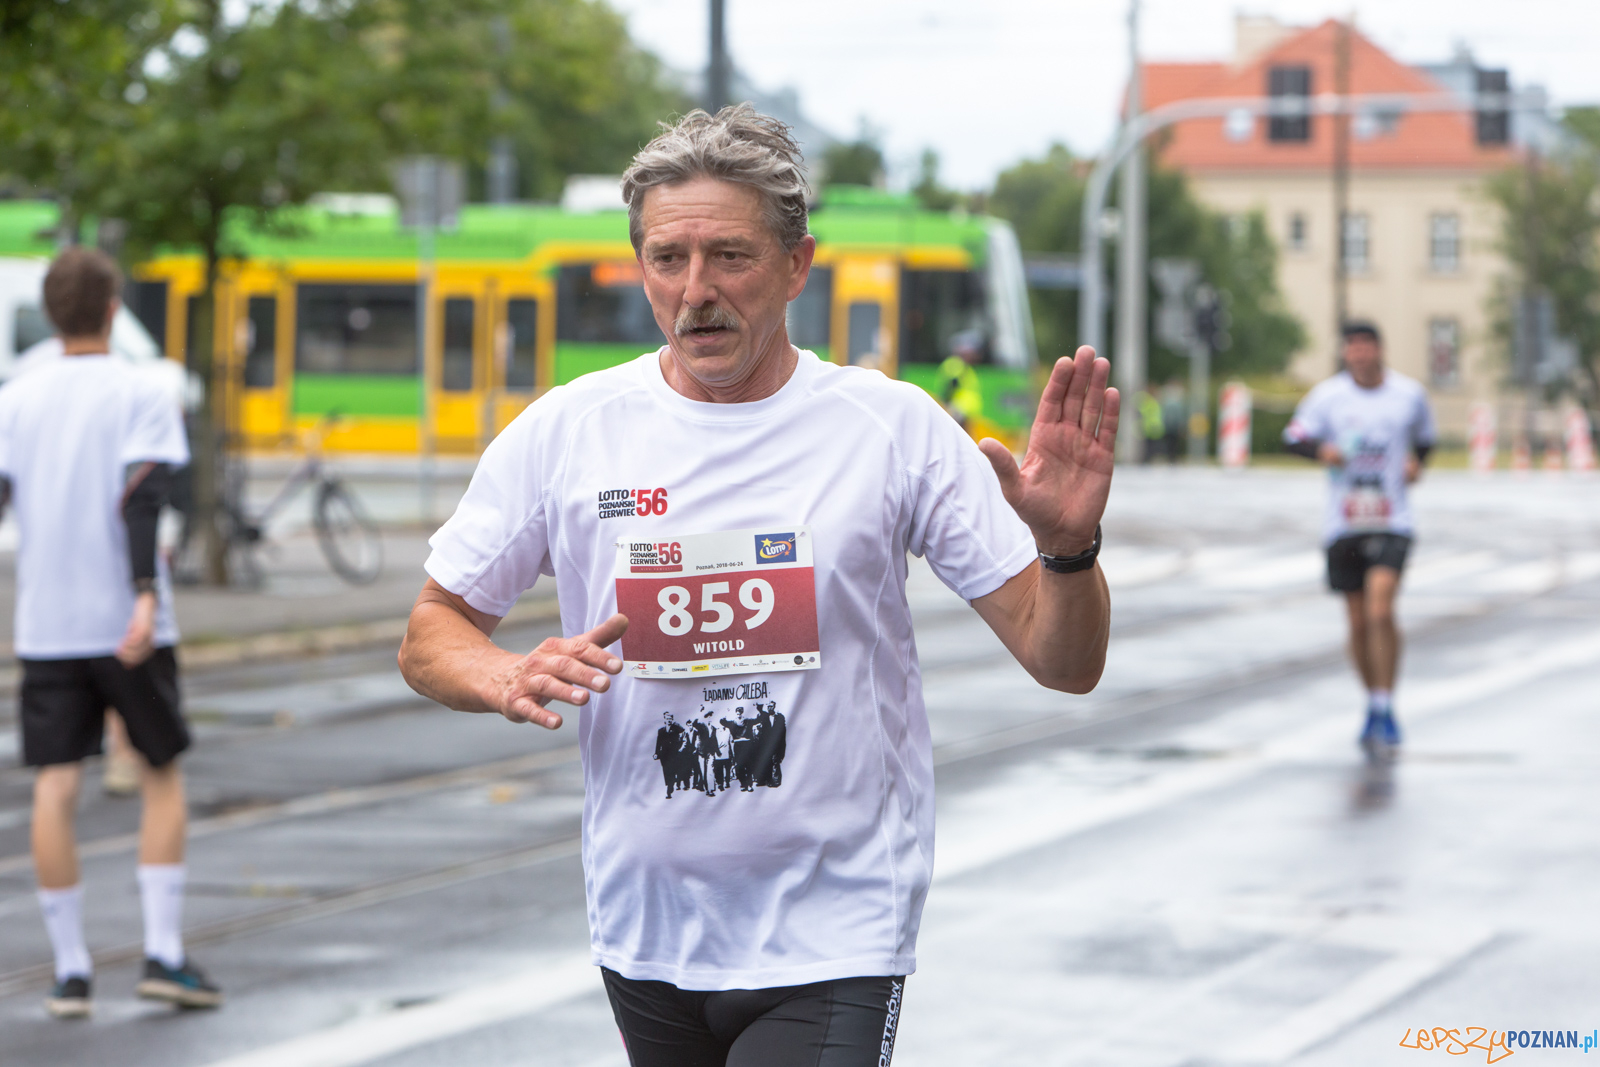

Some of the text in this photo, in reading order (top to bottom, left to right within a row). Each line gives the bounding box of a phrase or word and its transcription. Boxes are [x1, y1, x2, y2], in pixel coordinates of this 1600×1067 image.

[599, 489, 629, 502] LOTTO
[599, 499, 635, 510] POZNAŃSKI
[599, 508, 635, 519] CZERWIEC
[630, 543, 653, 552] LOTTO
[766, 544, 786, 556] LOTTO
[716, 561, 744, 569] 2018-06-24
[657, 578, 775, 636] 859
[693, 639, 745, 654] WITOLD
[735, 681, 768, 700] CHLEBA
[878, 980, 901, 1067] OSTRÓW
